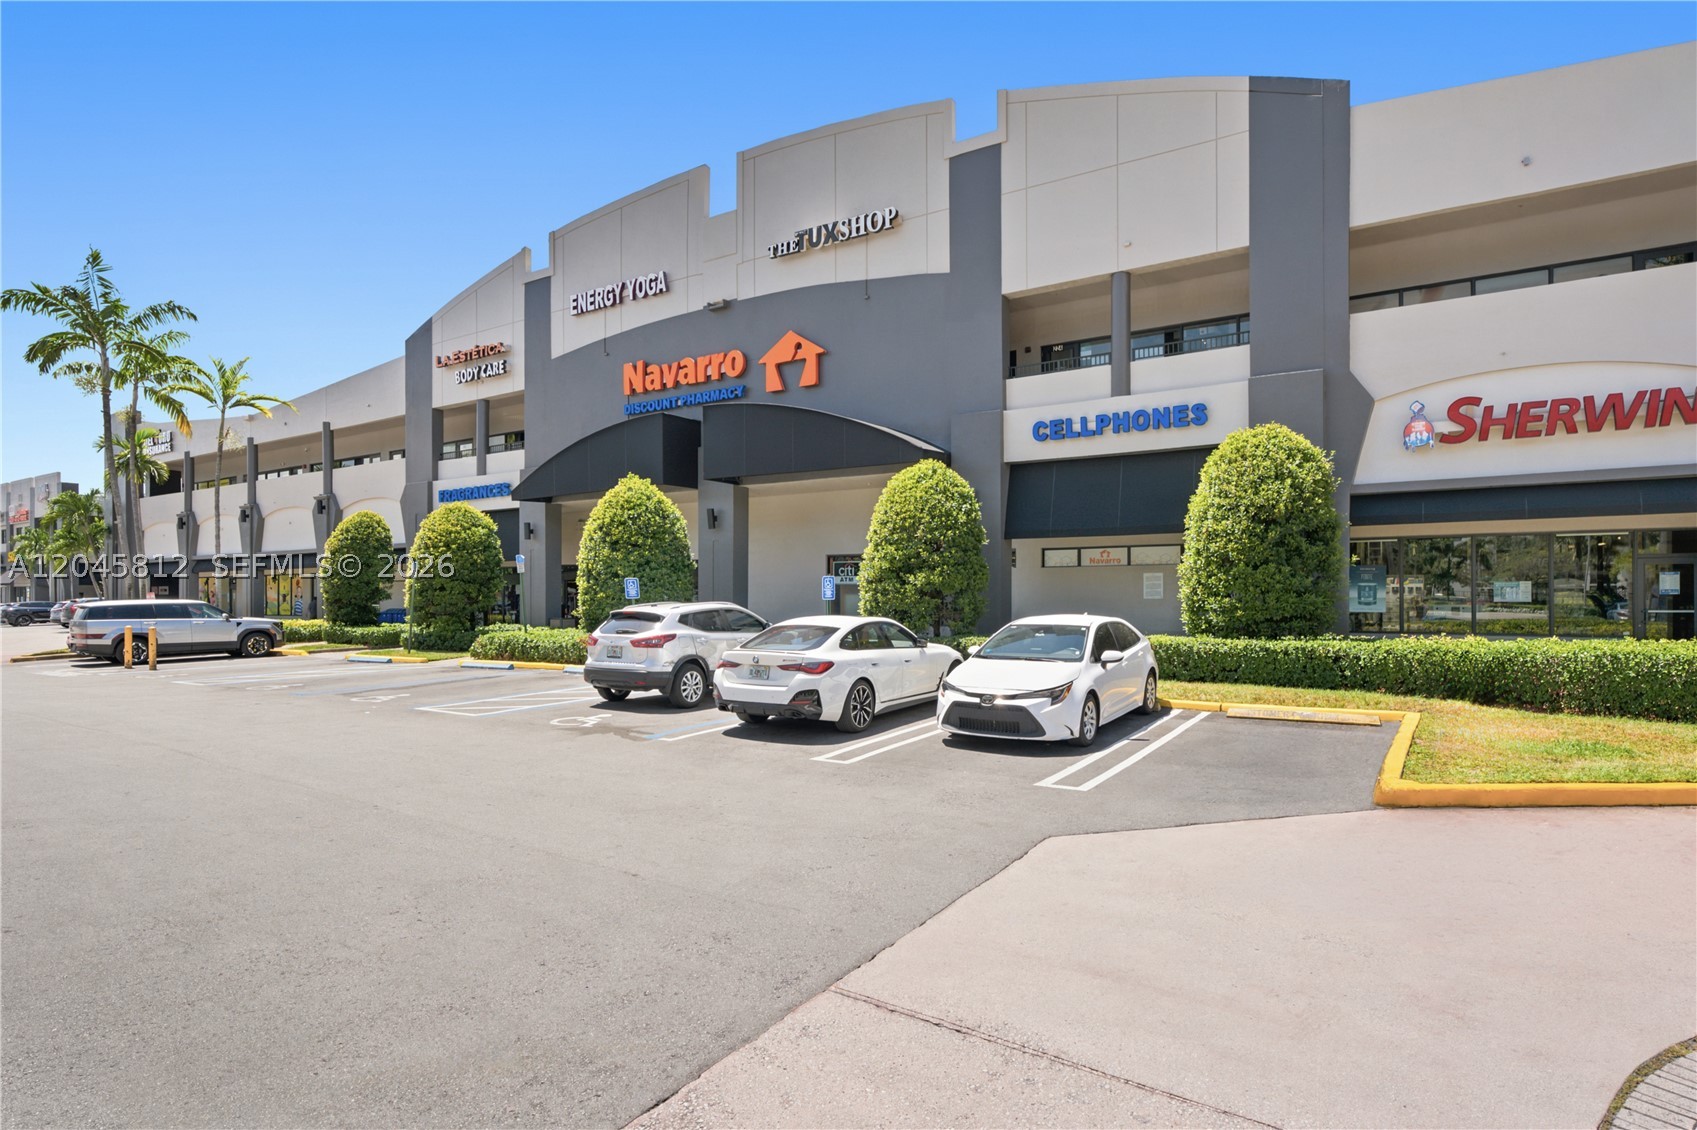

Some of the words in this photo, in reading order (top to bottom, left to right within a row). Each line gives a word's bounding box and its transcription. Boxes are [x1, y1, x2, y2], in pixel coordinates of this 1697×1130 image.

[569, 281, 622, 317] ENERGY
[624, 270, 669, 303] YOGA
[455, 366, 481, 384] BODY
[481, 360, 506, 377] CARE
[623, 349, 746, 396] Navarro
[623, 396, 681, 416] DISCOUNT
[680, 384, 746, 406] PHARMACY
[1439, 386, 1697, 444] SHERWIN
[1032, 402, 1209, 443] CELLPHONES
[438, 482, 512, 503] FRAGRANCES
[1089, 557, 1121, 565] Navarro
